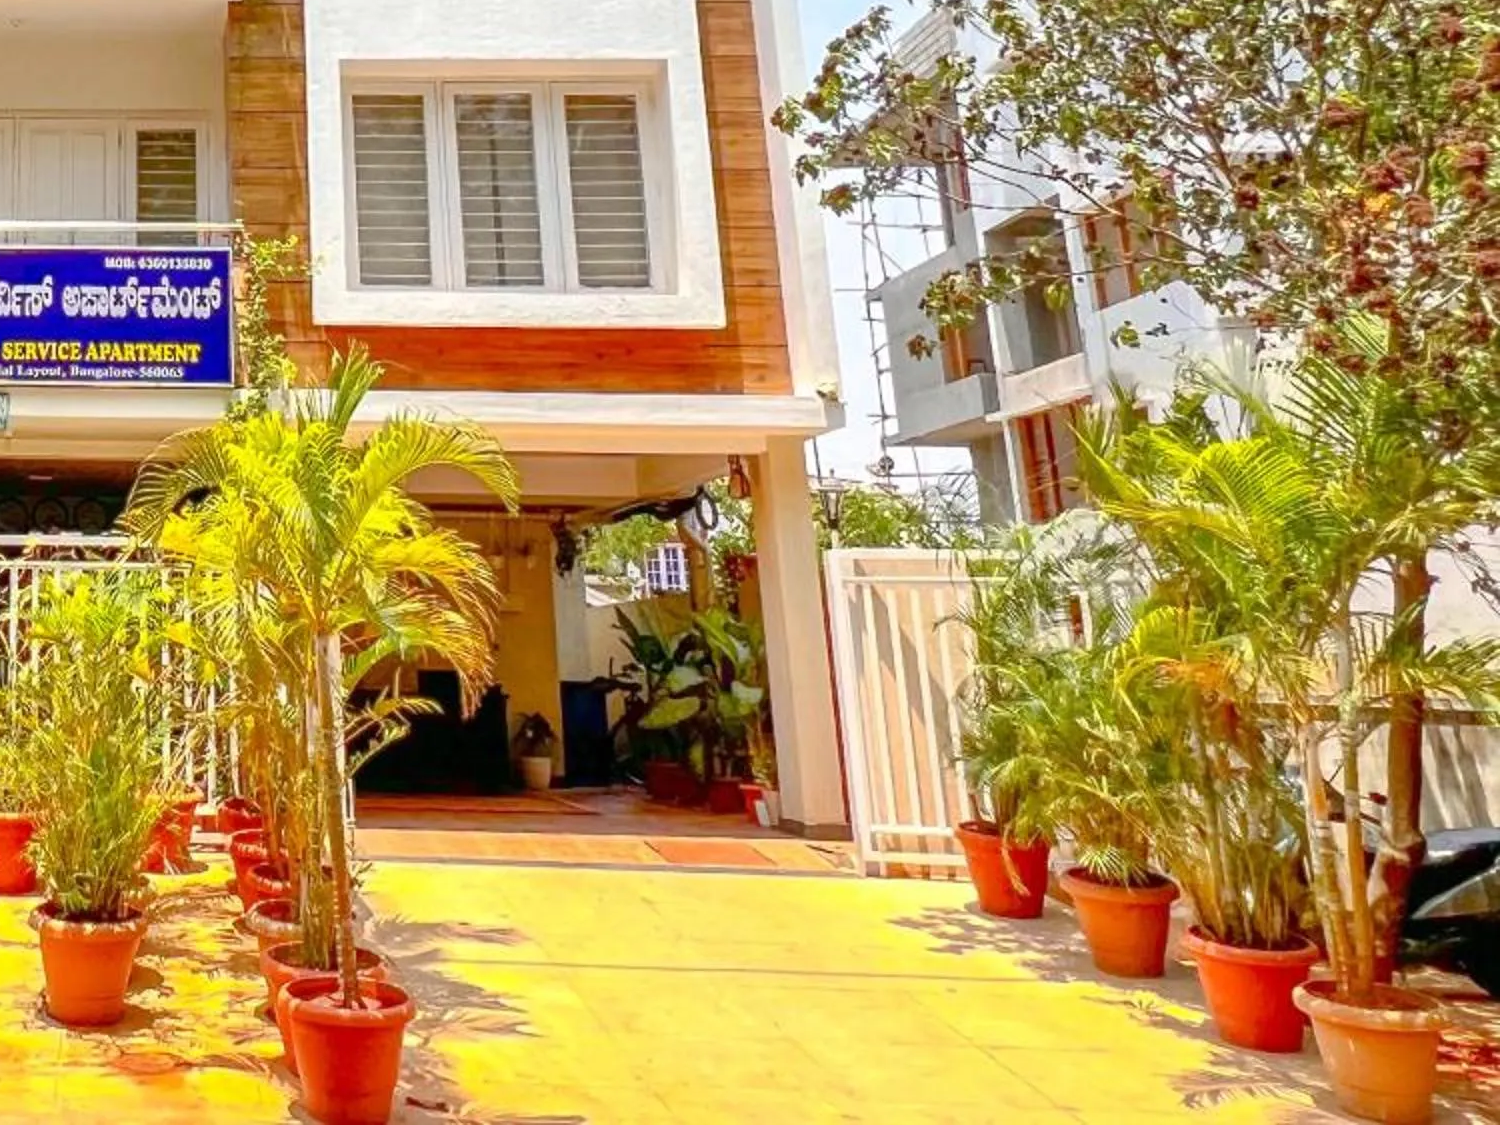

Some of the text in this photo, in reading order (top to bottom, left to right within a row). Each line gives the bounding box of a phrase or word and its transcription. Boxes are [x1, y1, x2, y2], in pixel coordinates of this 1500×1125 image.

[1, 342, 82, 362] SERVICE
[85, 342, 202, 364] APARTMENT
[16, 364, 67, 379] Layout,
